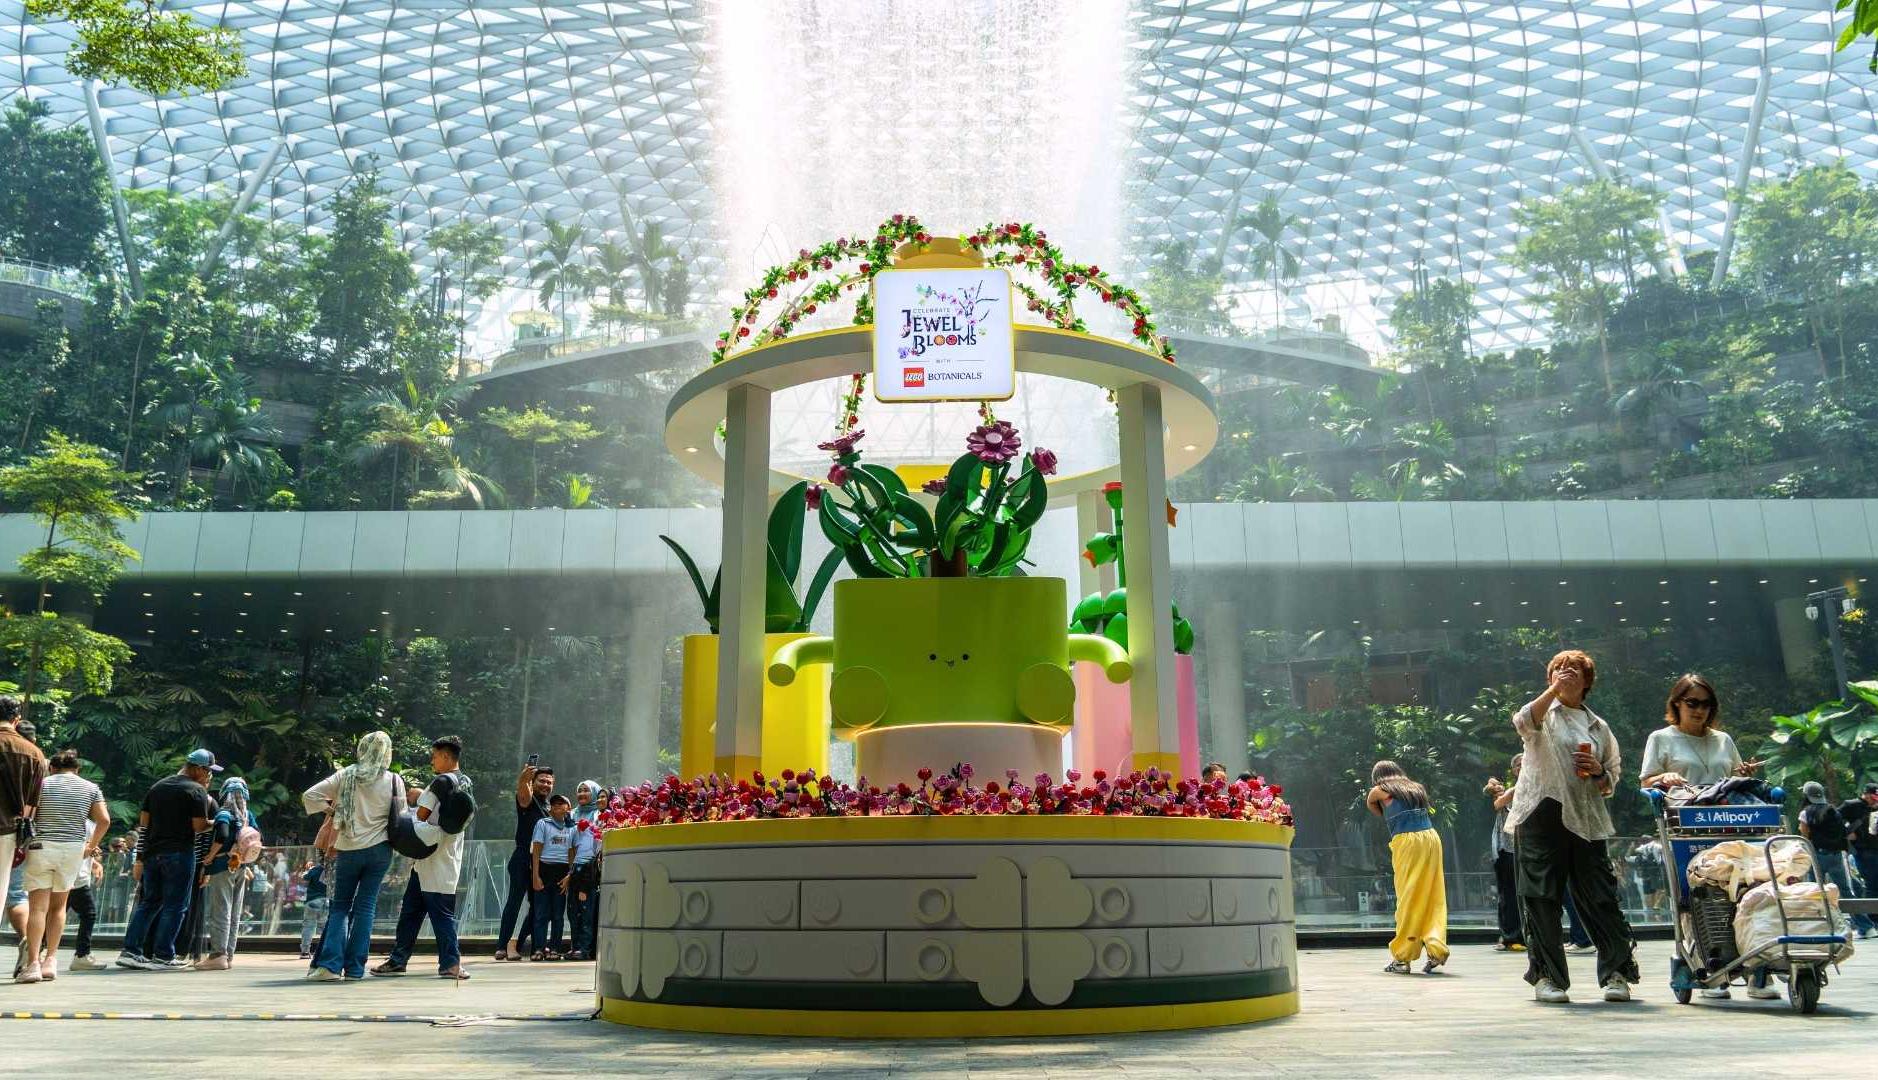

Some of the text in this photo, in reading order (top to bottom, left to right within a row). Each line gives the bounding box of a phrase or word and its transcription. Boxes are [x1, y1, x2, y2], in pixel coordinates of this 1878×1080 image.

[901, 310, 961, 338] JEWEL
[912, 334, 977, 356] BLOOMS
[928, 372, 982, 381] BOTANICALS
